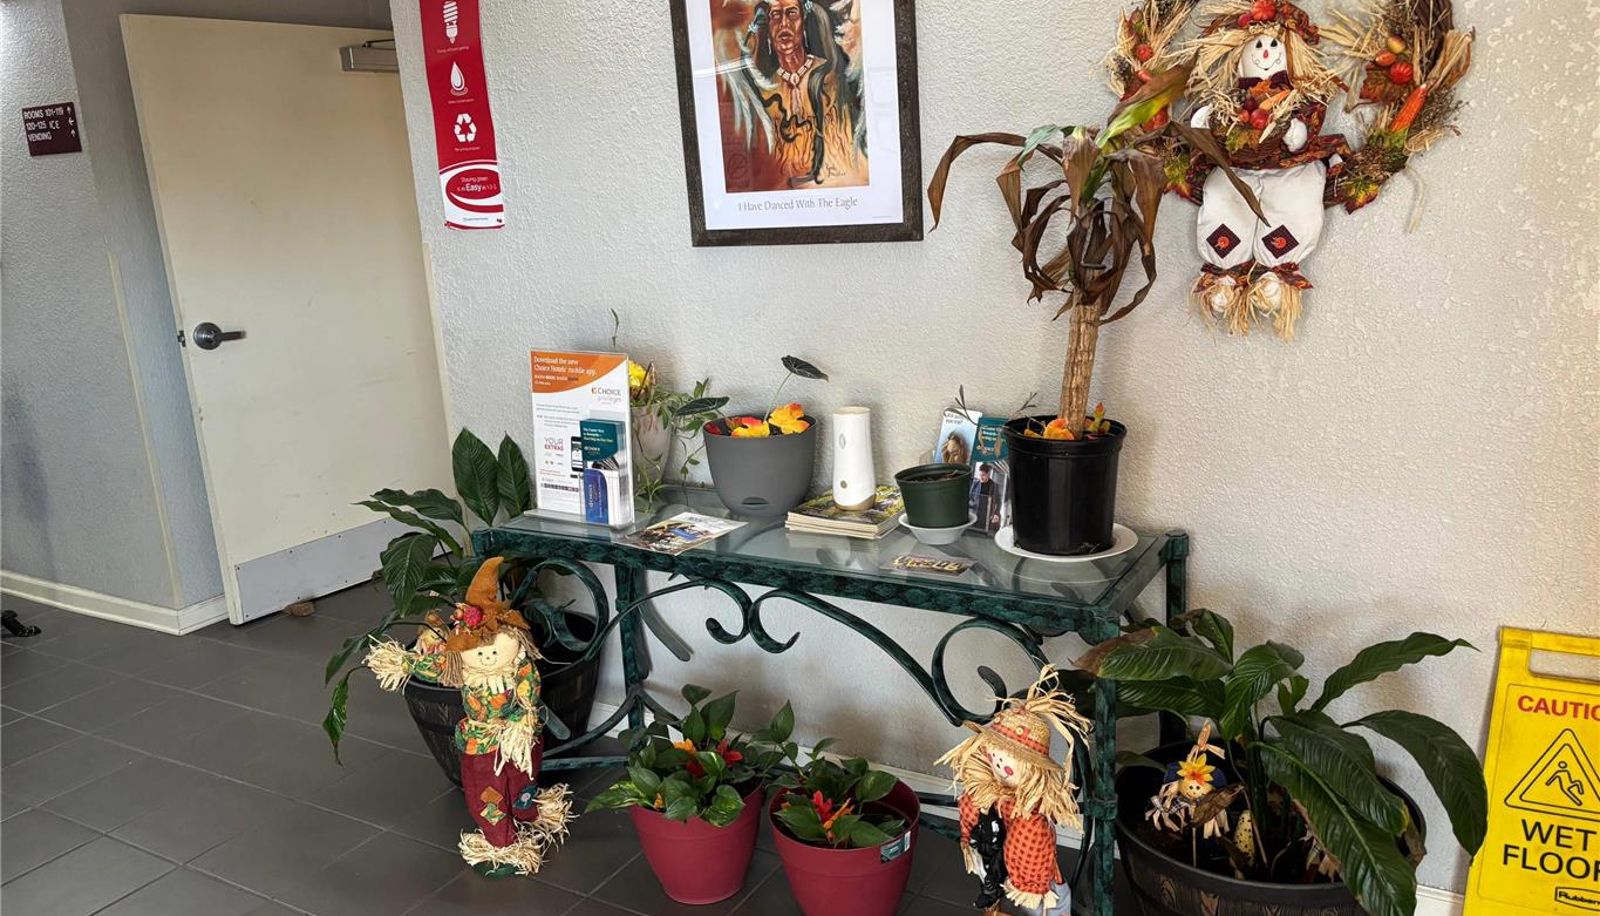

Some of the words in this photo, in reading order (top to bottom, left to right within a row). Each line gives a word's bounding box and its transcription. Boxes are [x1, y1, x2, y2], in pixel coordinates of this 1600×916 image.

[24, 110, 44, 119] ROOMS
[49, 120, 60, 130] ICE
[28, 131, 52, 142] VENDING
[465, 183, 482, 192] Easy
[743, 202, 763, 211] Have
[764, 200, 794, 210] Danced
[795, 199, 815, 209] With
[817, 198, 833, 208] The
[835, 196, 858, 210] Eagle
[533, 355, 558, 364] Download
[567, 366, 585, 374] mobile
[597, 388, 621, 396] CHOICE
[544, 436, 563, 445] YOUR
[1521, 818, 1597, 851] WET
